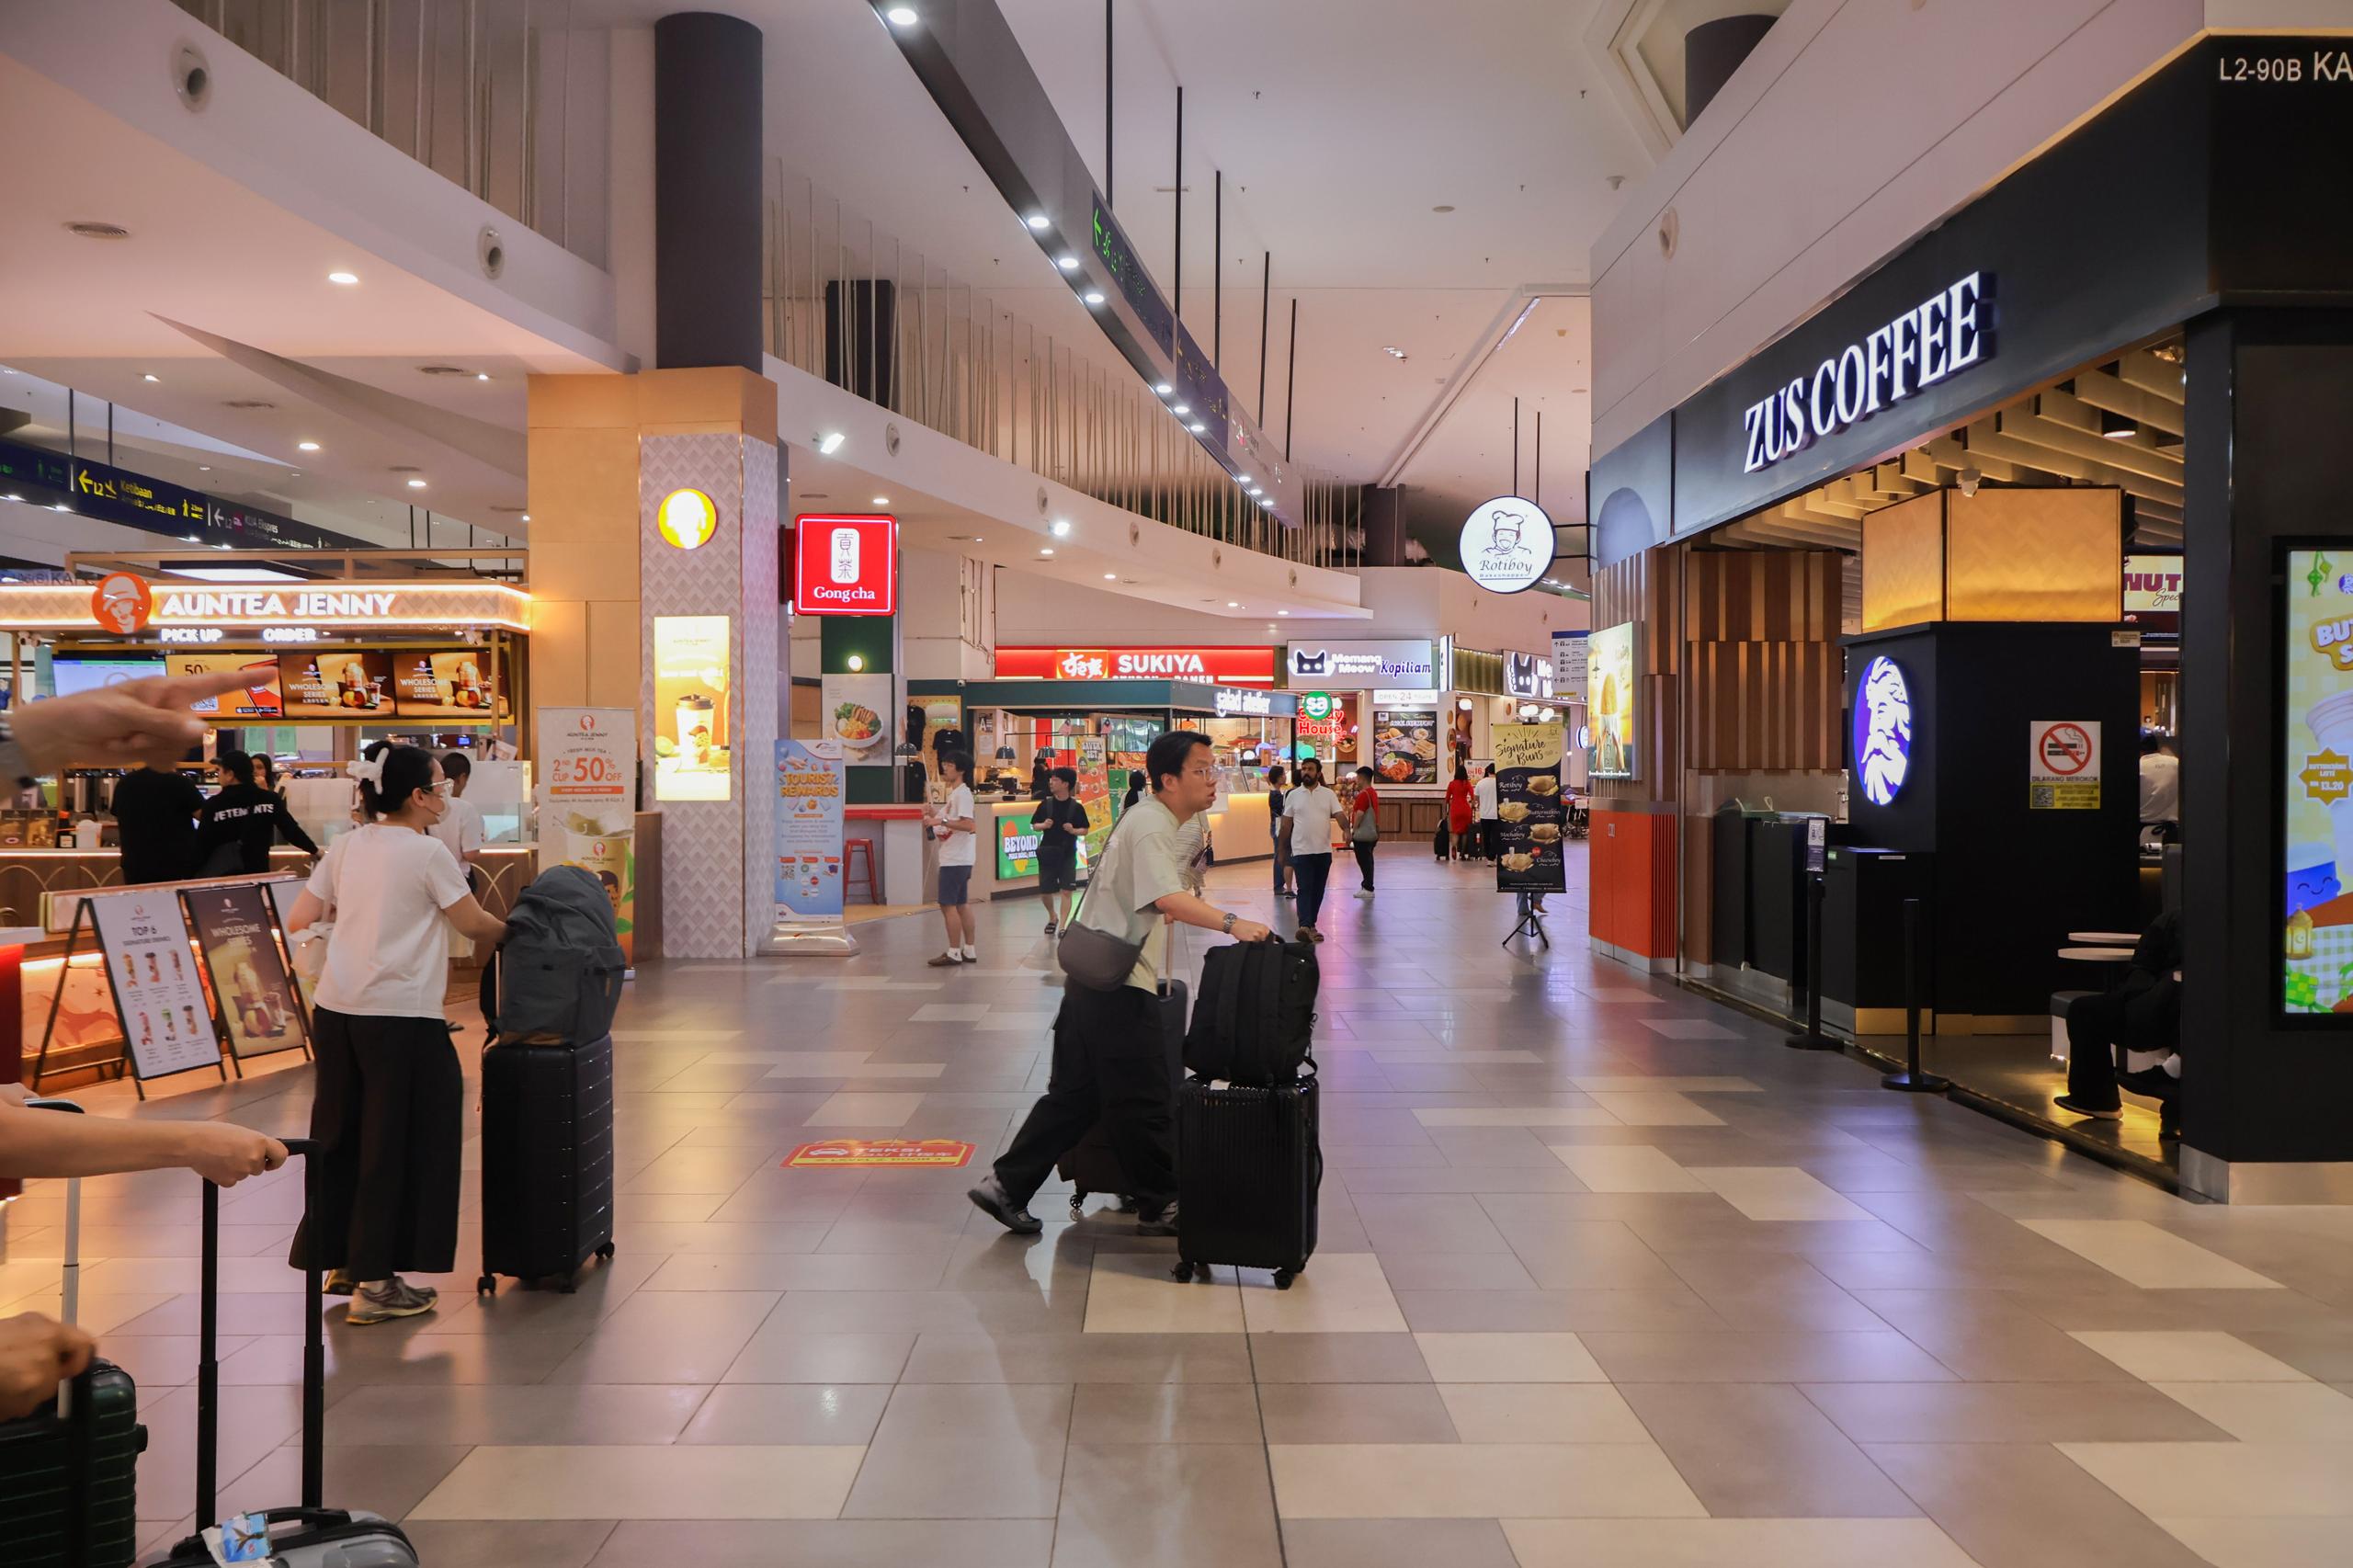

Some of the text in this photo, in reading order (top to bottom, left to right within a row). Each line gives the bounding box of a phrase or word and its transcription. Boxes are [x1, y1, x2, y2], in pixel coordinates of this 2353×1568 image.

[2220, 51, 2353, 82] L2-90B KA
[1744, 271, 1980, 473] ZUS COFFEE
[837, 533, 854, 579] 貢茶
[1479, 559, 1532, 575] Rotiboy
[813, 585, 875, 603] Gong cha
[161, 592, 397, 617] AUNTEA JENNY
[160, 628, 223, 642] PICK UP
[262, 628, 317, 642] ORDER
[1118, 653, 1204, 674] SUKIYA
[1332, 653, 1382, 665] Memang
[1338, 663, 1376, 674] Meow
[1380, 660, 1432, 678] Kopiliam
[303, 690, 326, 699] SERIES
[414, 686, 436, 694] SERIES
[1400, 691, 1412, 701] 24
[1298, 721, 1342, 735] House
[1495, 738, 1546, 759] Signature
[1517, 750, 1544, 767] Buns
[552, 772, 622, 782] CUP OFF
[784, 773, 837, 786] TOURIST
[779, 785, 839, 798] REWARDS
[1004, 835, 1039, 853] BEYOND
[131, 926, 151, 938] TOP
